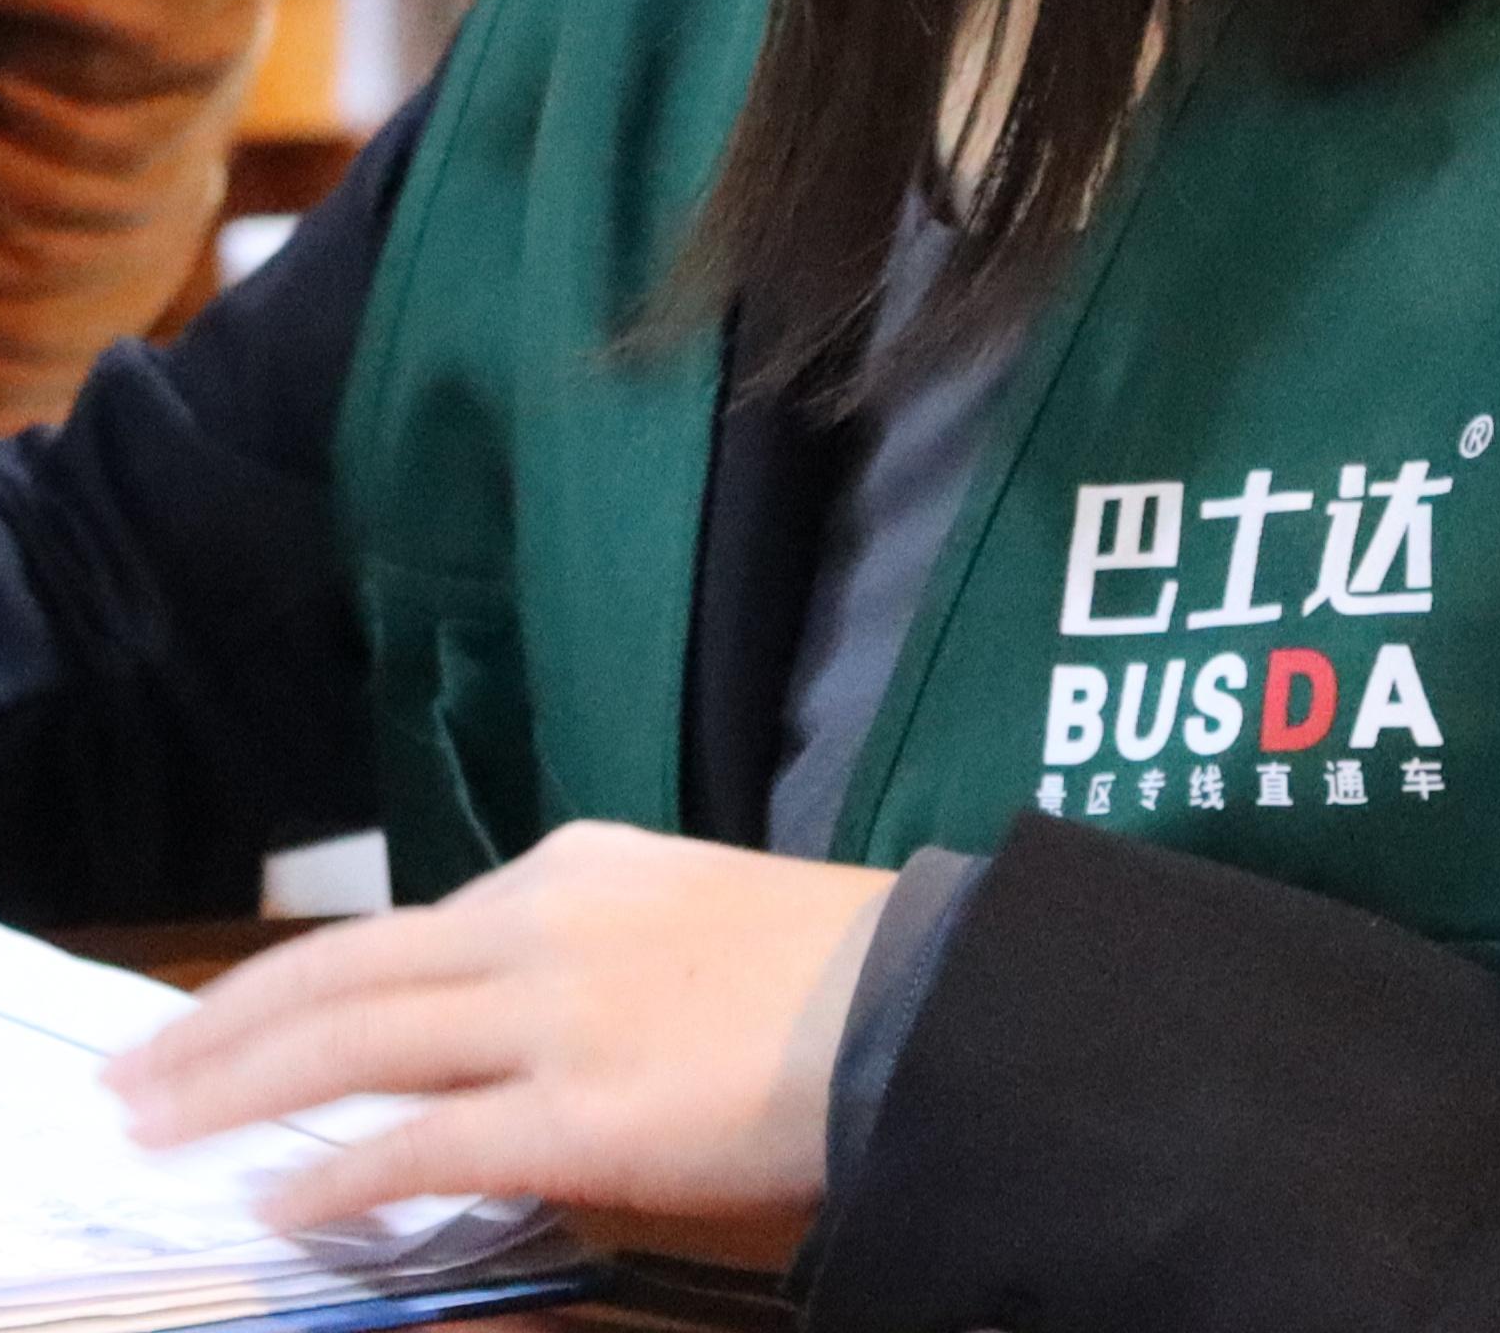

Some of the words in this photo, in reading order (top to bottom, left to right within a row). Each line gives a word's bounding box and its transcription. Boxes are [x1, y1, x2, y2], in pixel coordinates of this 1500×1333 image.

[1060, 460, 1453, 636] 巴士达
[1043, 644, 1444, 766] BUSDA
[1037, 758, 1445, 818] 景区专线直通车
